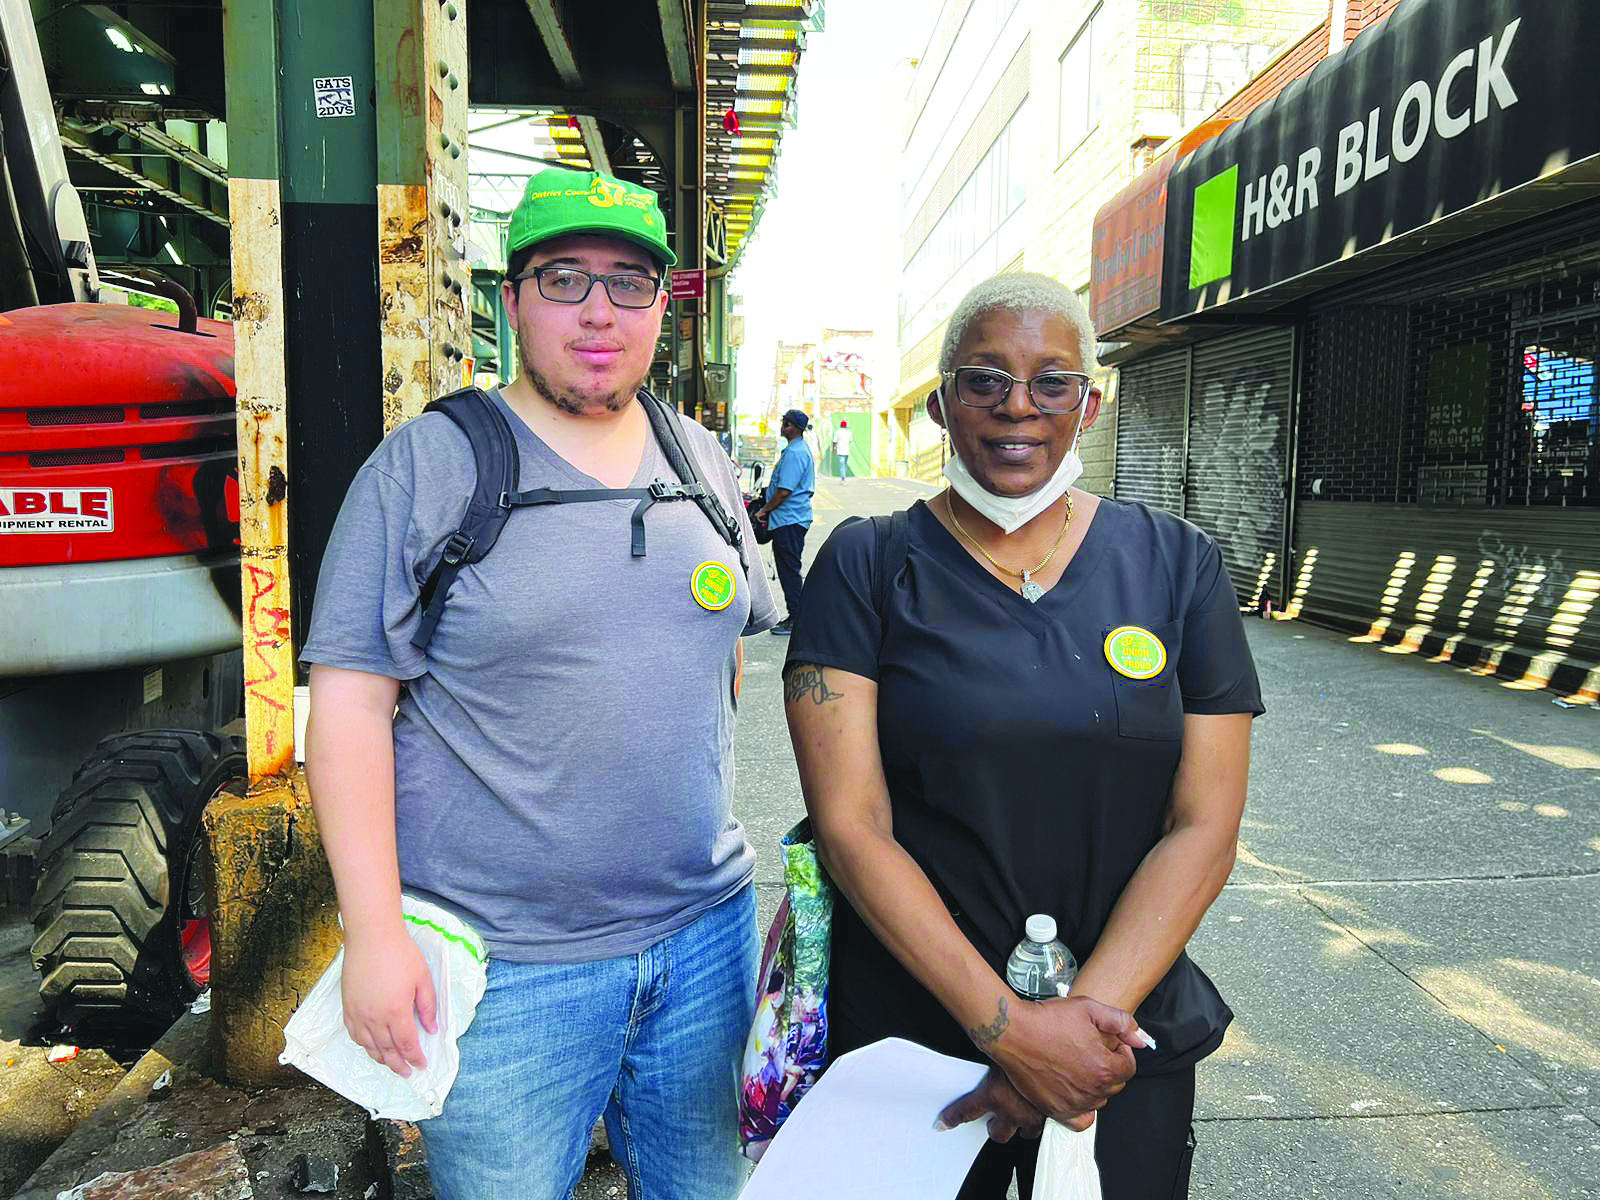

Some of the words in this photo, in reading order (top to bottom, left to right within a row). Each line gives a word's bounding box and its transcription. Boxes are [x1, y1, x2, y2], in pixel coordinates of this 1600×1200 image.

[315, 78, 351, 89] GATS
[318, 106, 354, 115] 2DVS
[1241, 147, 1322, 242] H&R
[1334, 17, 1522, 197] BLOCK
[531, 189, 563, 201] District
[58, 520, 108, 528] RENTAL
[1123, 648, 1150, 657] UNION
